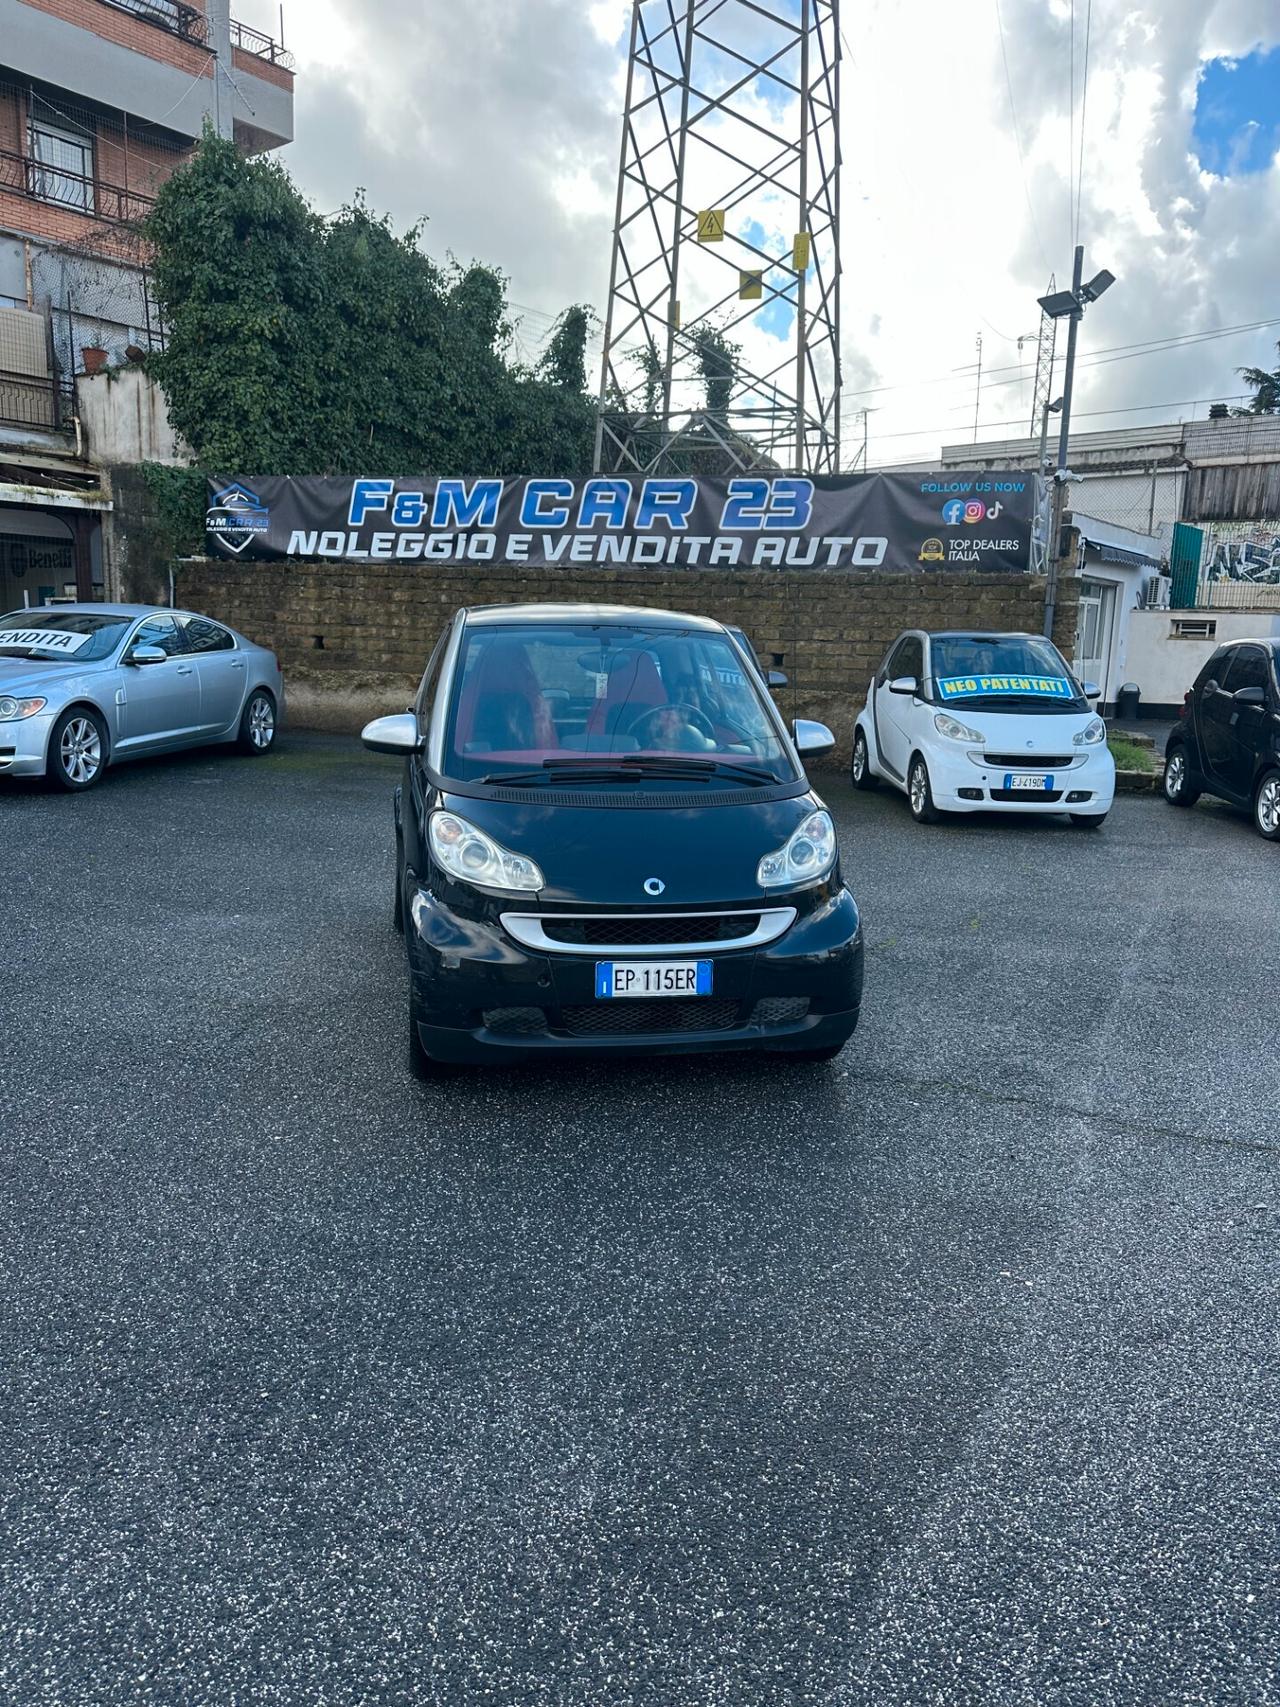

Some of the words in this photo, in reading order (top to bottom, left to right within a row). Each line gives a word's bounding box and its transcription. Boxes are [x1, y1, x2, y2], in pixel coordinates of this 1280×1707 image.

[921, 482, 972, 493] FOLLOW
[975, 482, 991, 492] US
[994, 482, 1025, 493] NOW
[348, 479, 504, 528] F&M
[519, 478, 698, 530] CAR
[718, 478, 815, 530] 23
[286, 530, 498, 561] NOLEGGIO
[505, 533, 533, 561] E
[541, 534, 743, 565] VENDITA
[751, 536, 889, 566] AUTO
[949, 539, 970, 550] TOP
[973, 539, 1019, 551] DEALERS
[948, 550, 980, 561] ITALIA
[943, 679, 978, 693] NEO
[980, 678, 1064, 693] PATENTATI
